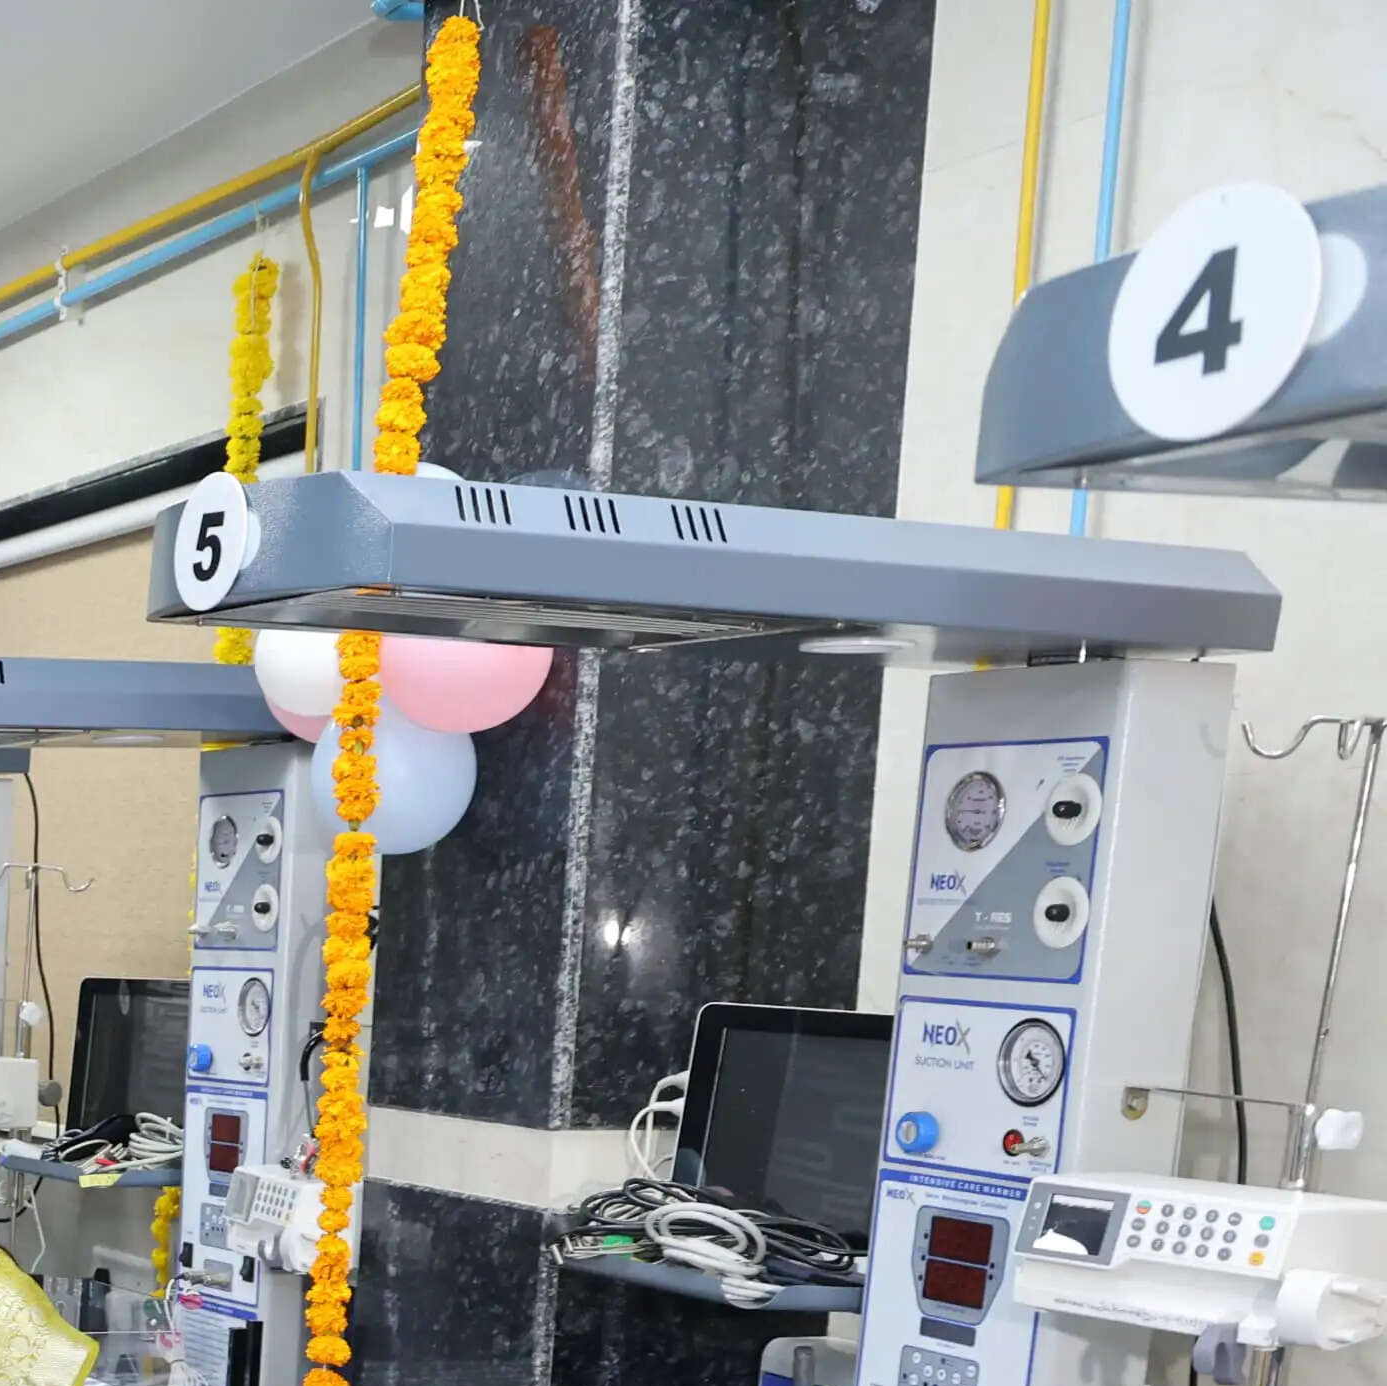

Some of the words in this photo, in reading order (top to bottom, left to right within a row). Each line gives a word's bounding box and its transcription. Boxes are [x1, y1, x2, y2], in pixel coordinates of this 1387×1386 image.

[1154, 245, 1243, 376] 4
[193, 510, 225, 582] 5
[923, 1018, 971, 1056] NEOX
[915, 1056, 952, 1068] SUCTION
[954, 1060, 975, 1071] UNIT
[909, 1174, 956, 1189] INTENSIVE
[958, 1181, 981, 1193] CARE
[983, 1184, 1022, 1199] WARMER
